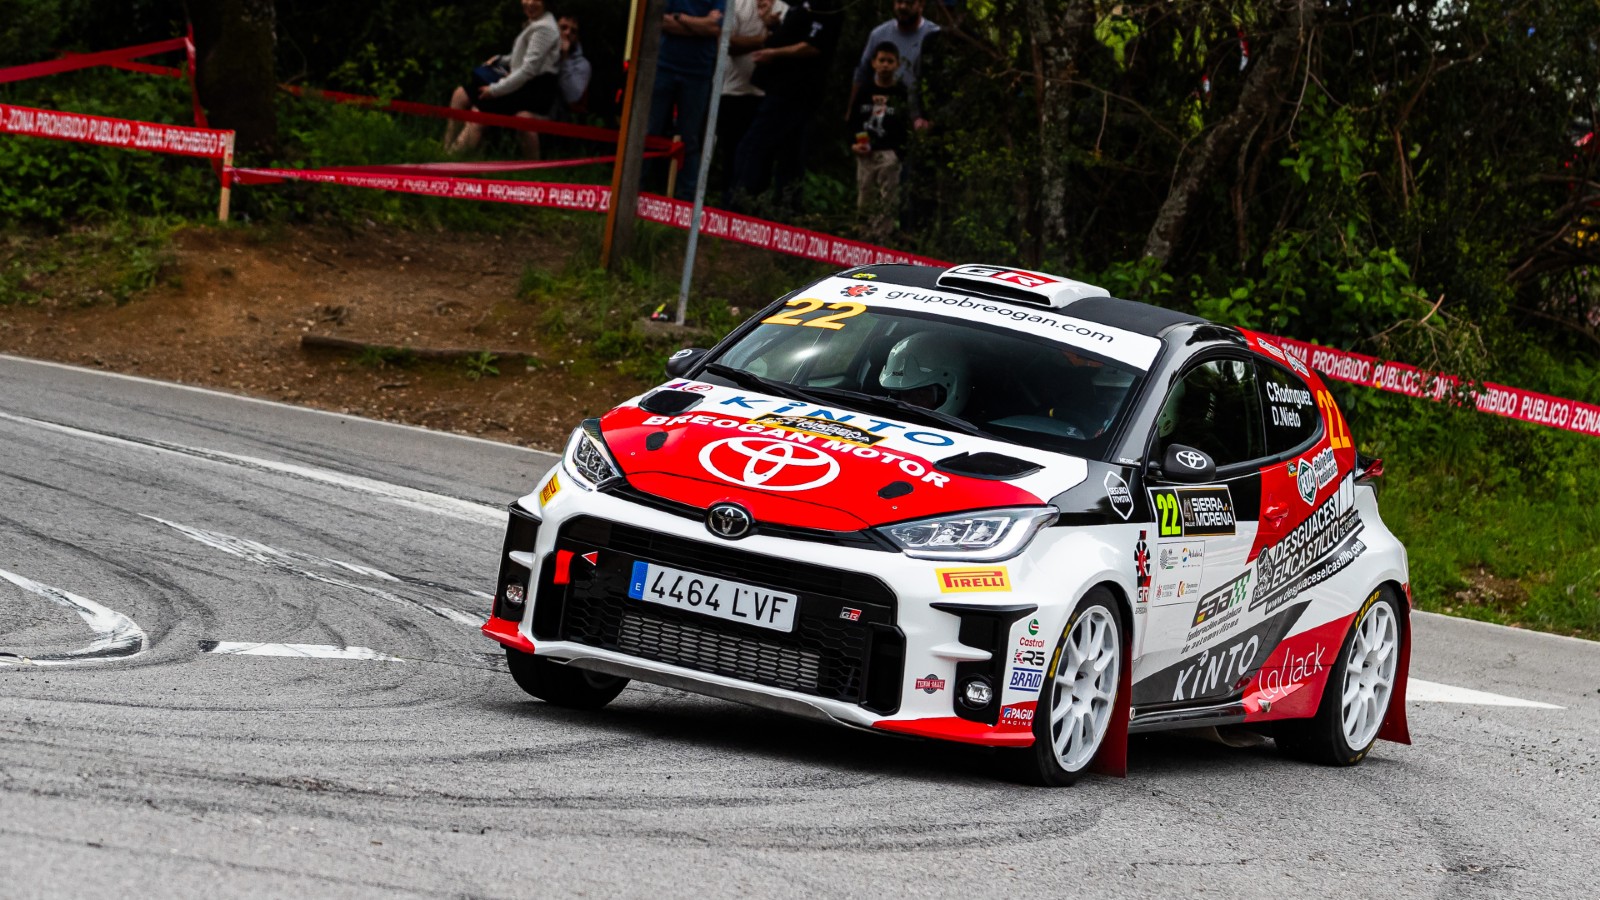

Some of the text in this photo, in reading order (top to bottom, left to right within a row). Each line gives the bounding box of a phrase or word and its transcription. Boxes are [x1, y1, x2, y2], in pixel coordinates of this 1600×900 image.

[8, 109, 35, 132] ZONA
[37, 113, 88, 140] PROHIBIDO
[88, 121, 131, 145] PUBLICO
[135, 125, 163, 146] ZONA
[163, 128, 218, 153] PROHIBIDO
[454, 182, 482, 197] ZONA
[487, 184, 544, 203] PROHIBIDO
[549, 187, 595, 208] PUBLICO
[707, 212, 729, 236] ZONA
[730, 217, 771, 246] PROHIBIDO
[772, 228, 807, 253] PUBLICO
[808, 236, 829, 258] ZONA
[760, 297, 867, 331] 22
[885, 289, 1114, 344] grupobreogan.com
[1312, 350, 1370, 382] PROHIBIDO
[1519, 395, 1569, 426] PUBLICO
[1271, 405, 1301, 428] D.Nieto
[1317, 389, 1351, 449] 22
[642, 414, 819, 444] BREOGAN
[821, 442, 951, 488] MOTOR
[1157, 493, 1181, 536] 22
[1191, 497, 1224, 511] SIERRA
[1194, 511, 1235, 527] MORENA
[1274, 497, 1335, 565] DESGUACES
[1290, 519, 1339, 576] CASTILLO
[635, 582, 641, 591] E
[942, 571, 1005, 588] PIRELLI
[650, 571, 789, 624] 4464 LVF
[1019, 637, 1045, 648] Castrol
[1009, 671, 1043, 689] BRAID
[1001, 719, 1033, 727] RACING
[1010, 707, 1035, 720] PAGID
